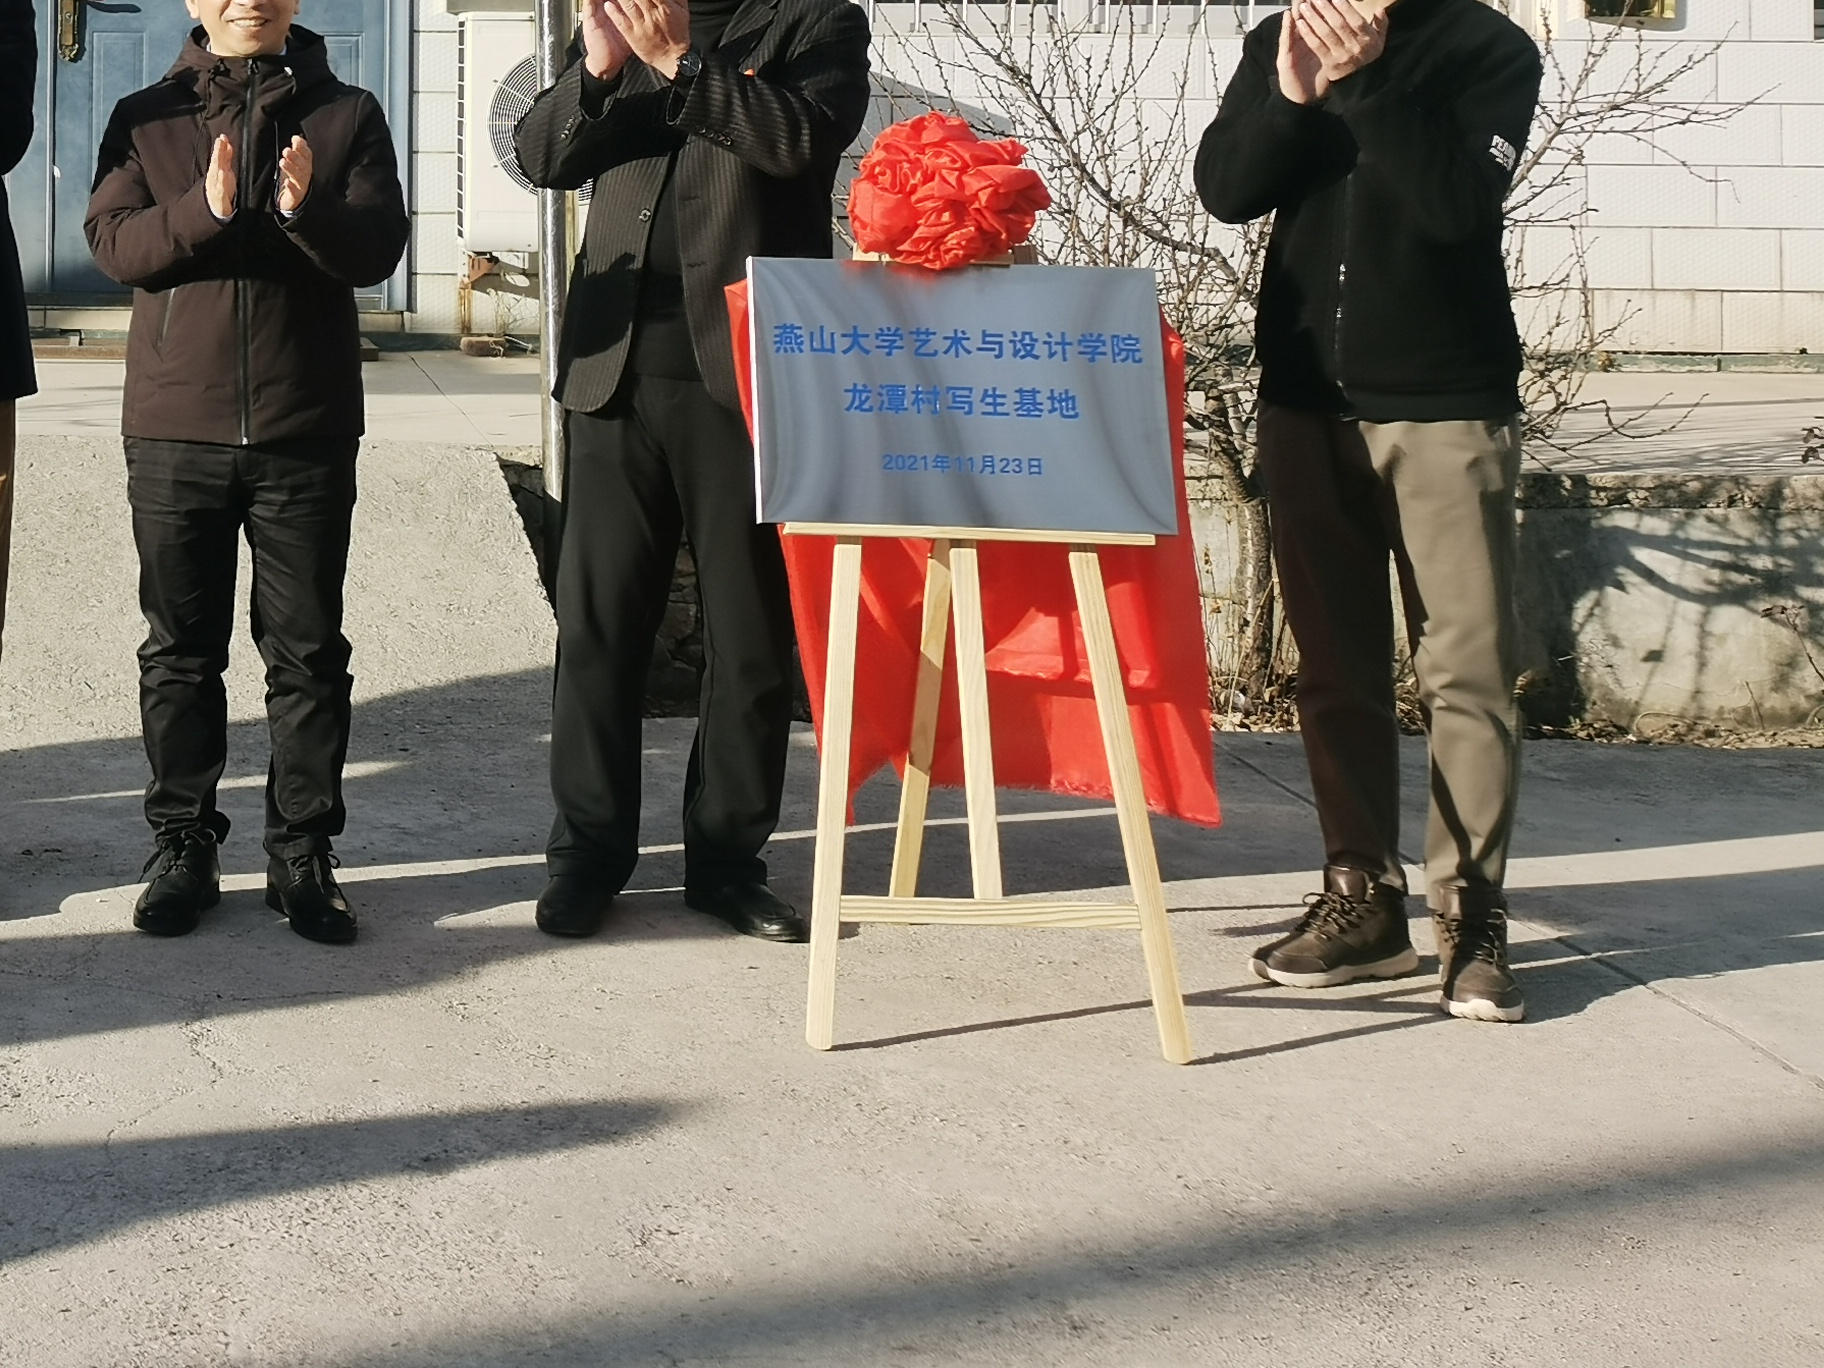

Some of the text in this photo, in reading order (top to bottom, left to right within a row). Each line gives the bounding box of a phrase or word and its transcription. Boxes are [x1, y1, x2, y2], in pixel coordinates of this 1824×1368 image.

[773, 324, 1144, 364] 燕山大学艺术与设计学院
[844, 383, 1080, 420] 龙潭村写生基地
[882, 453, 1044, 476] 2021年11月23日
